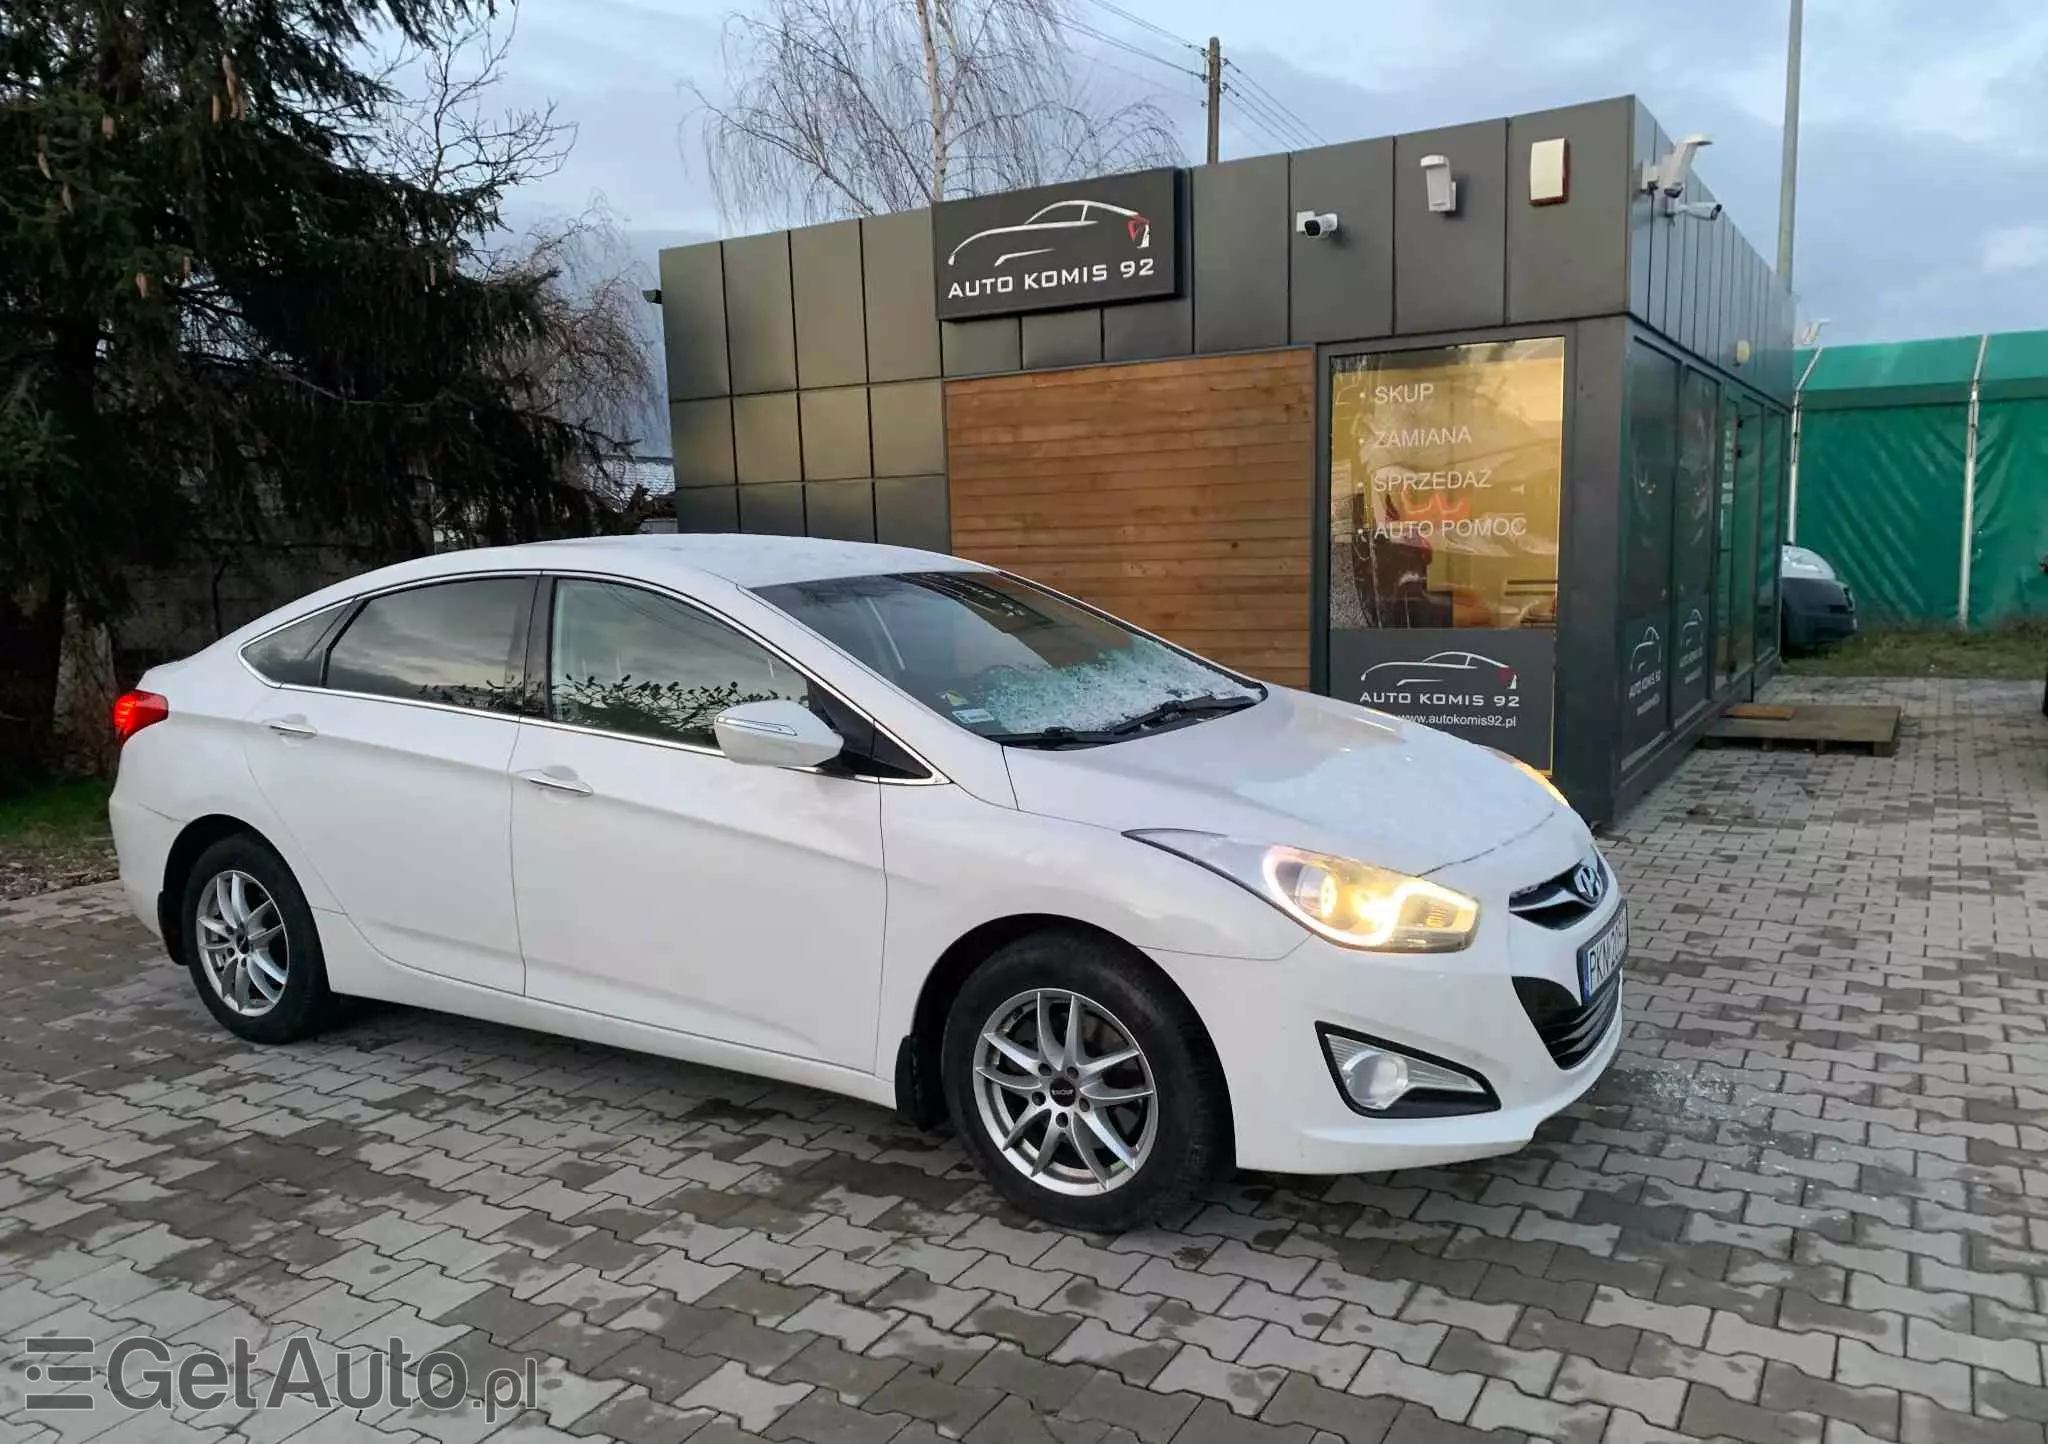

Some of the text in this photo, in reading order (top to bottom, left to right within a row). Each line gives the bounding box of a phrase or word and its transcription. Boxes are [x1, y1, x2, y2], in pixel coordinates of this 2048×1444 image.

[948, 258, 1154, 299] AUTO KOMIS 92
[1375, 383, 1434, 404] SKUP
[1374, 425, 1472, 448] ZAMIANA
[1374, 517, 1527, 540] AUTO POMOC
[1359, 692, 1520, 707] AUTO KOMIS 92
